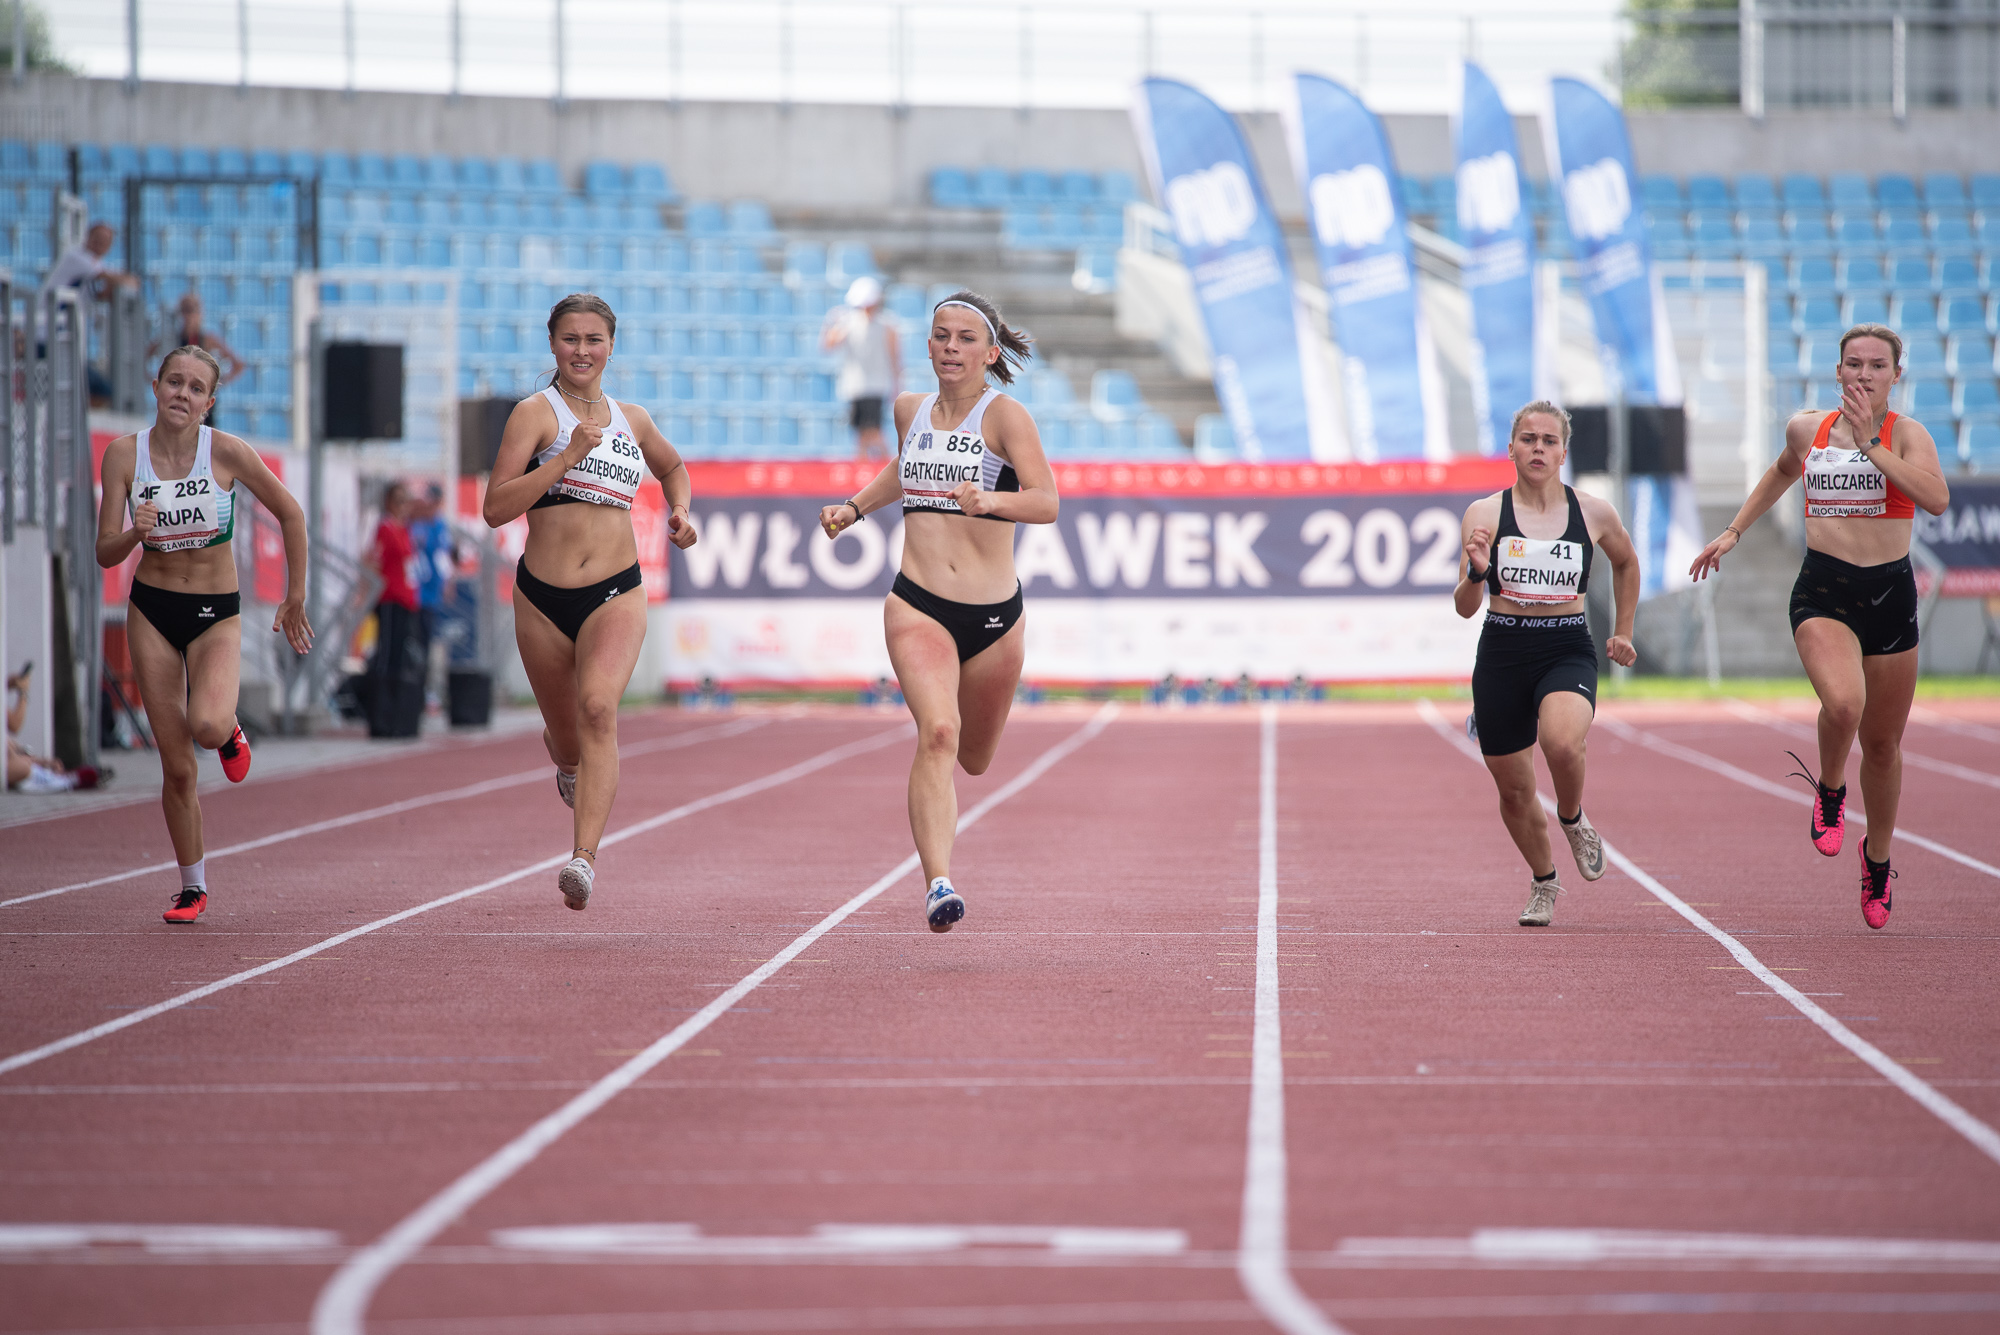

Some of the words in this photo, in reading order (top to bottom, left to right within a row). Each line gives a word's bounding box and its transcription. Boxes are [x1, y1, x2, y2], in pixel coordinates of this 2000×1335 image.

[612, 438, 640, 460] 858
[947, 435, 983, 455] 856
[572, 457, 640, 488] DZIĘBORSKA
[904, 461, 980, 483] BĄTKIEWICZ
[1807, 473, 1883, 490] MIELCZAREK
[174, 479, 210, 498] 282
[907, 497, 958, 508] WŁOCŁAWEK
[1812, 506, 1861, 515] WŁOCŁAWEK
[1863, 506, 1882, 515] 2021
[154, 507, 206, 527] RUPA
[684, 511, 1273, 590] WŁOAWEK
[1299, 507, 1463, 588] 202
[1549, 543, 1573, 560] 41
[1501, 567, 1578, 586] CZERNIAK
[1489, 614, 1516, 626] PRO
[1521, 618, 1557, 628] NIKE
[1558, 615, 1585, 627] PRO
